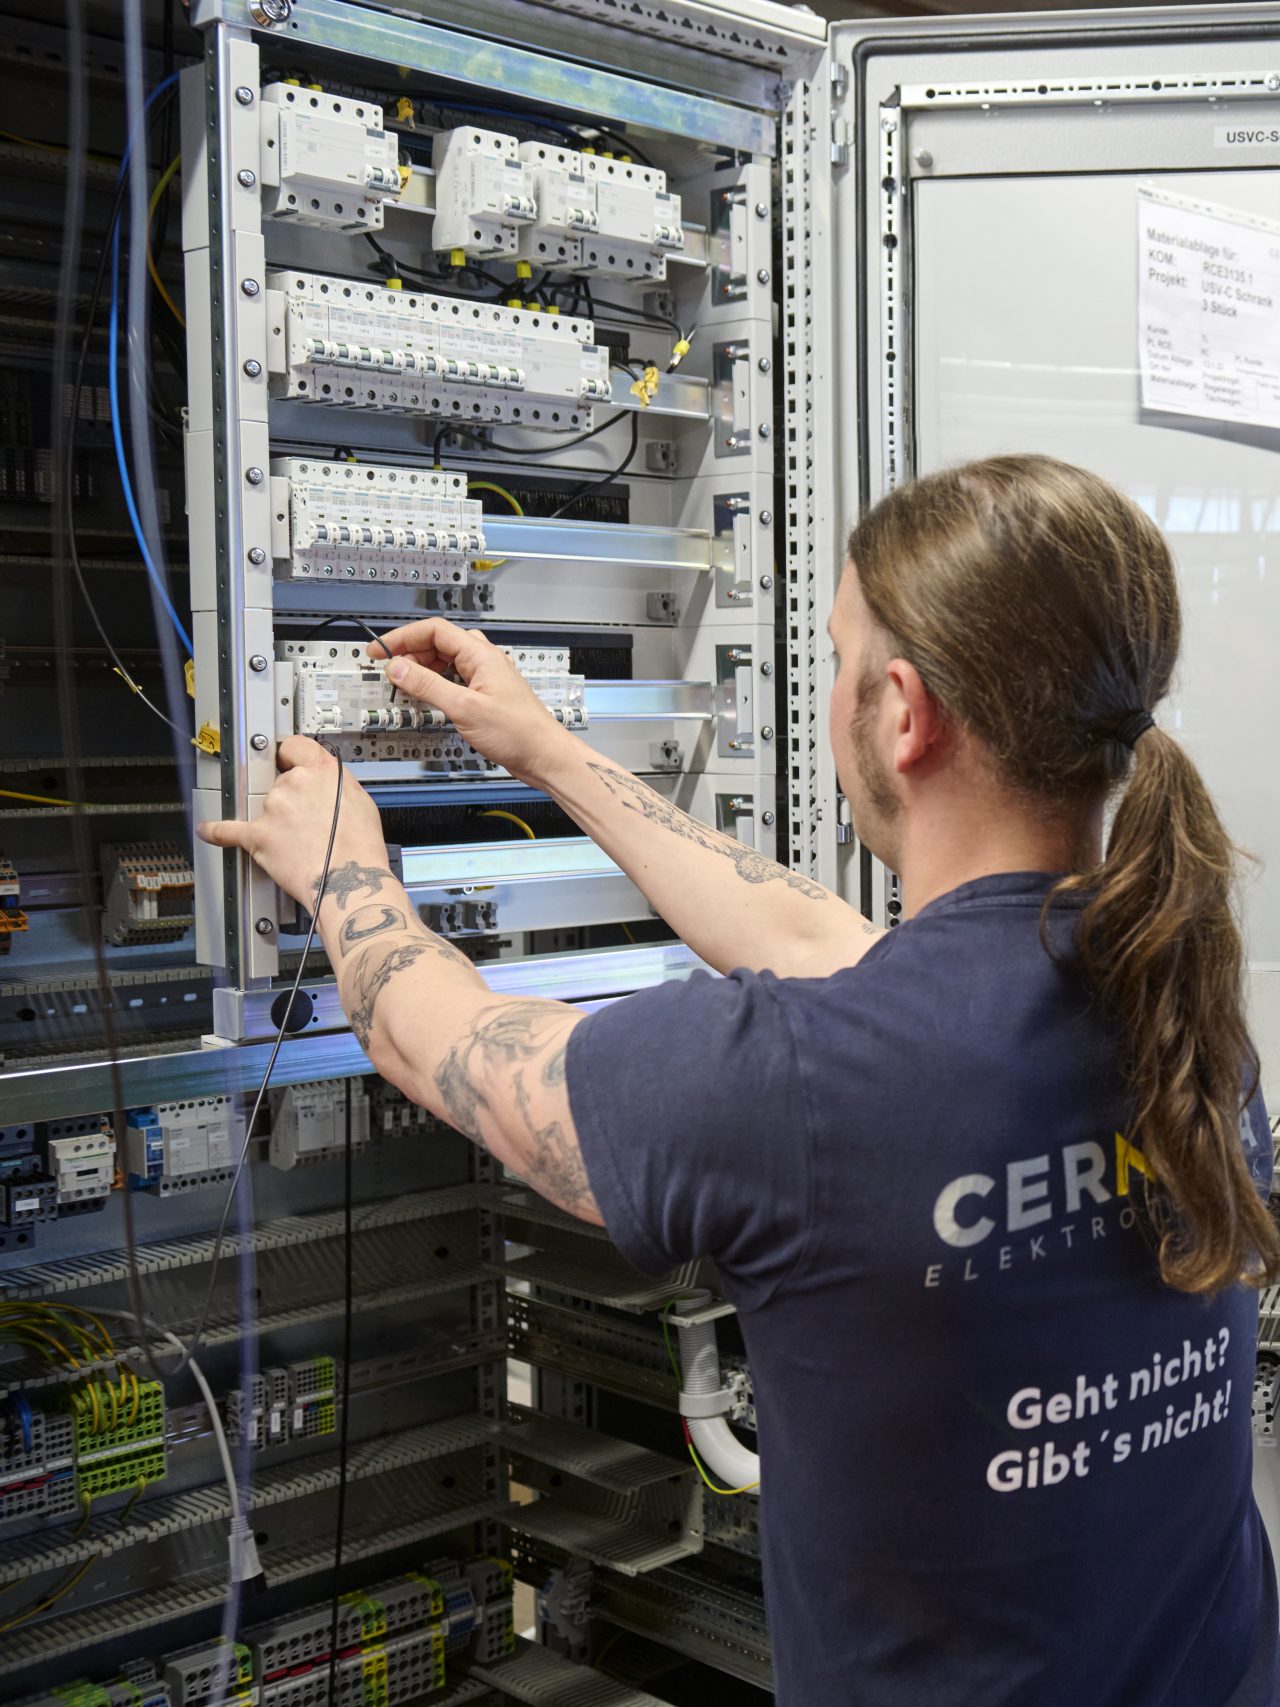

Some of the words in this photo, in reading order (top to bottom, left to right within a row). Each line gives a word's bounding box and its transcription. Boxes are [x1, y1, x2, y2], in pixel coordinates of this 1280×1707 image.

[1147, 227, 1220, 259] Materialablage
[1201, 280, 1233, 299] USV-C
[1235, 288, 1273, 308] Schrank
[1202, 298, 1208, 312] 3
[1210, 300, 1238, 318] Stück
[1006, 1375, 1119, 1430] Geht
[1129, 1327, 1230, 1401] nicht?
[1141, 1380, 1232, 1453] nicht!
